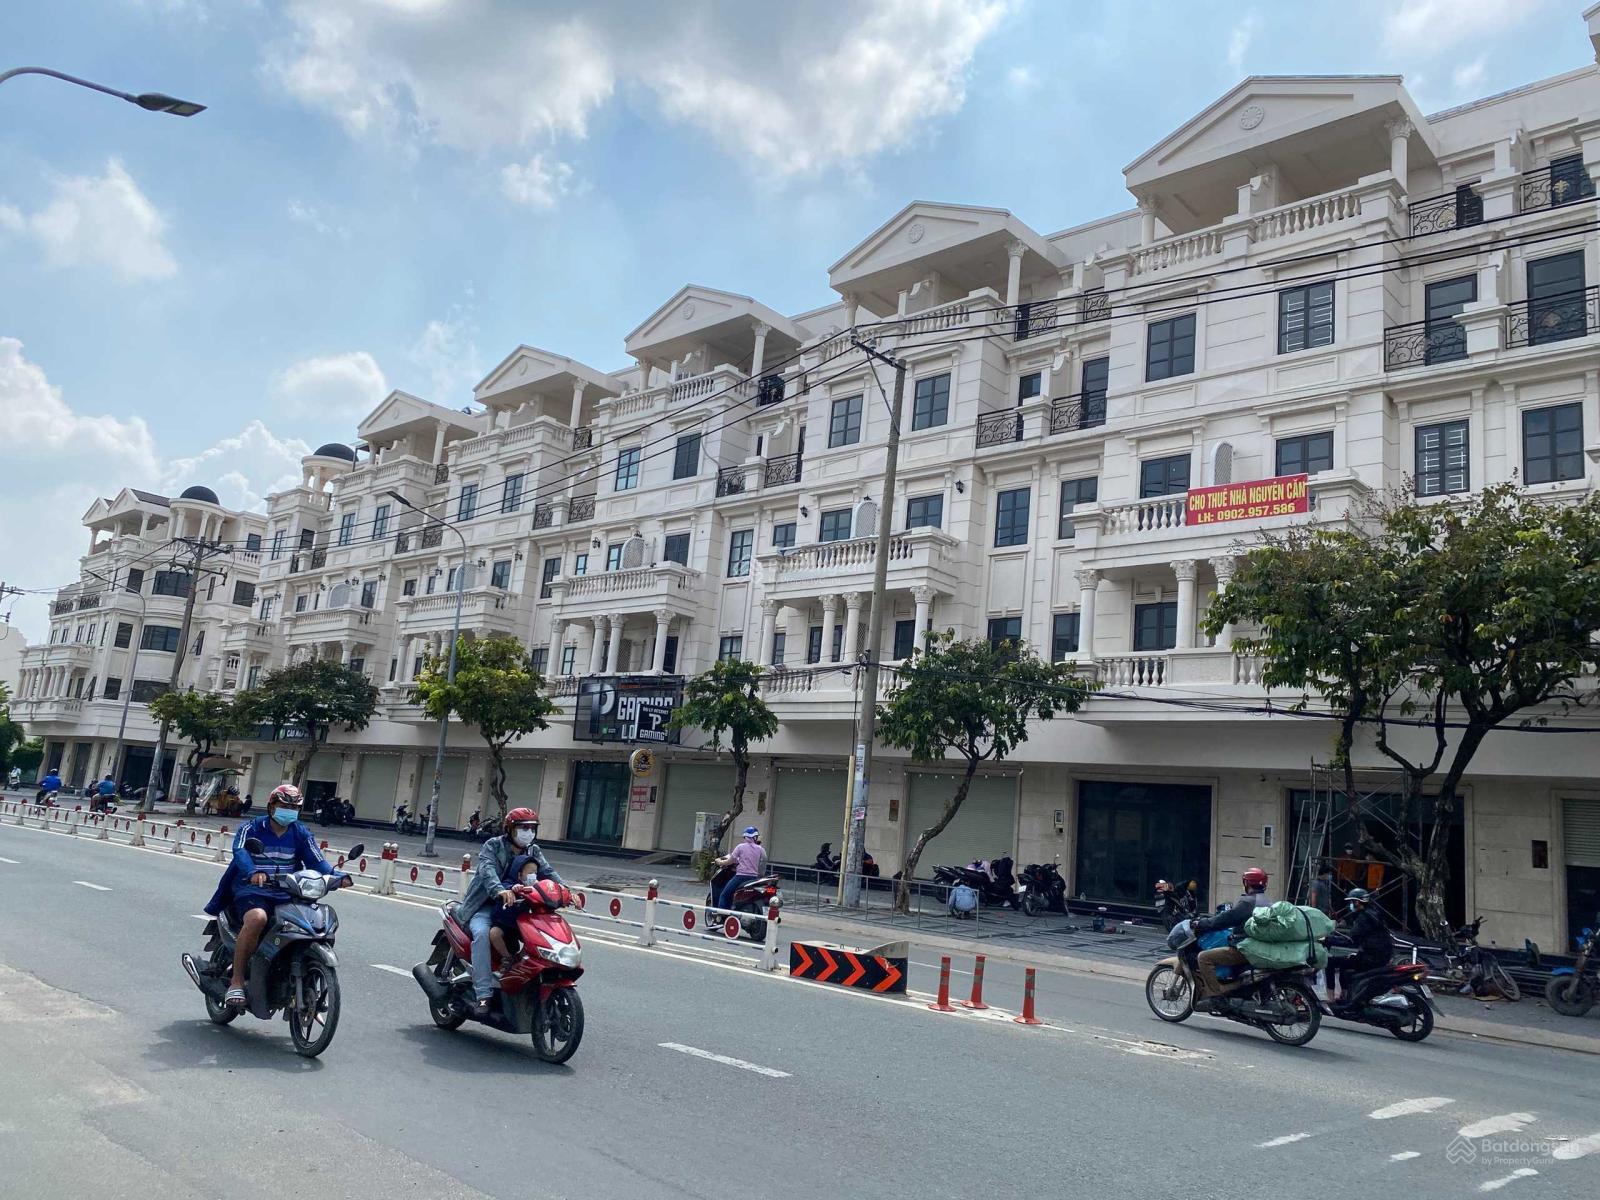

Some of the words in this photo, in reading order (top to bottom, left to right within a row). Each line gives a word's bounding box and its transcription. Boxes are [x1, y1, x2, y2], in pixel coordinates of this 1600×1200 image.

[1190, 494, 1206, 511] CHO
[1197, 512, 1214, 524] LH:
[1217, 503, 1296, 521] 0902.957.586
